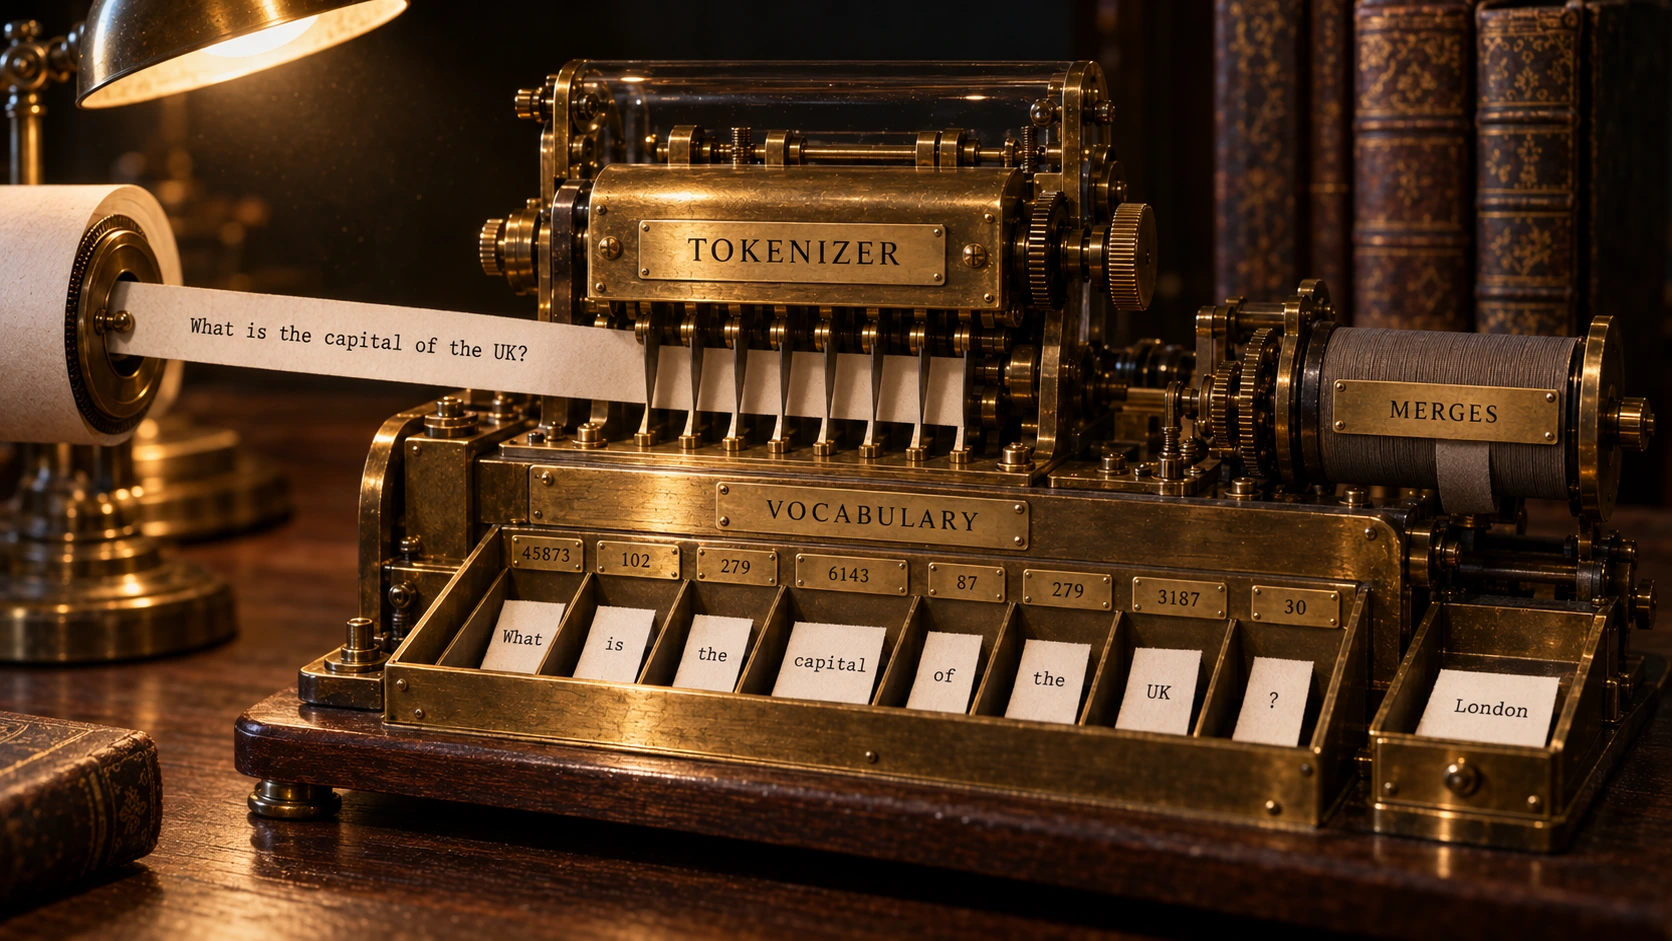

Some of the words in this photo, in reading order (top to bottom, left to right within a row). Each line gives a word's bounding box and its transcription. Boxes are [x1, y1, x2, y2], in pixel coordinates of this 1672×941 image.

[688, 238, 899, 265] TOKENIZER
[190, 317, 234, 337] What
[246, 321, 267, 340] is
[279, 324, 312, 344] the
[324, 331, 402, 352] capital
[415, 336, 438, 354] of
[449, 339, 482, 358] the
[493, 343, 528, 362] UK?
[1390, 400, 1498, 424] MERGES
[767, 499, 979, 532] VOCABULARY
[521, 545, 571, 563] 45873
[622, 552, 651, 569] 102
[720, 558, 751, 575] 279
[828, 565, 869, 583] 6143
[956, 574, 978, 591] 87
[1052, 581, 1084, 599] 279
[1157, 589, 1201, 607] 3187
[1284, 598, 1307, 616] 30
[503, 629, 543, 647] What
[604, 636, 625, 653] is
[698, 646, 728, 663] the
[794, 656, 866, 673] capital
[933, 667, 957, 683] of
[1033, 670, 1065, 688] the
[1147, 683, 1172, 701] UK
[1269, 691, 1279, 709] ?
[1454, 698, 1528, 719] London
